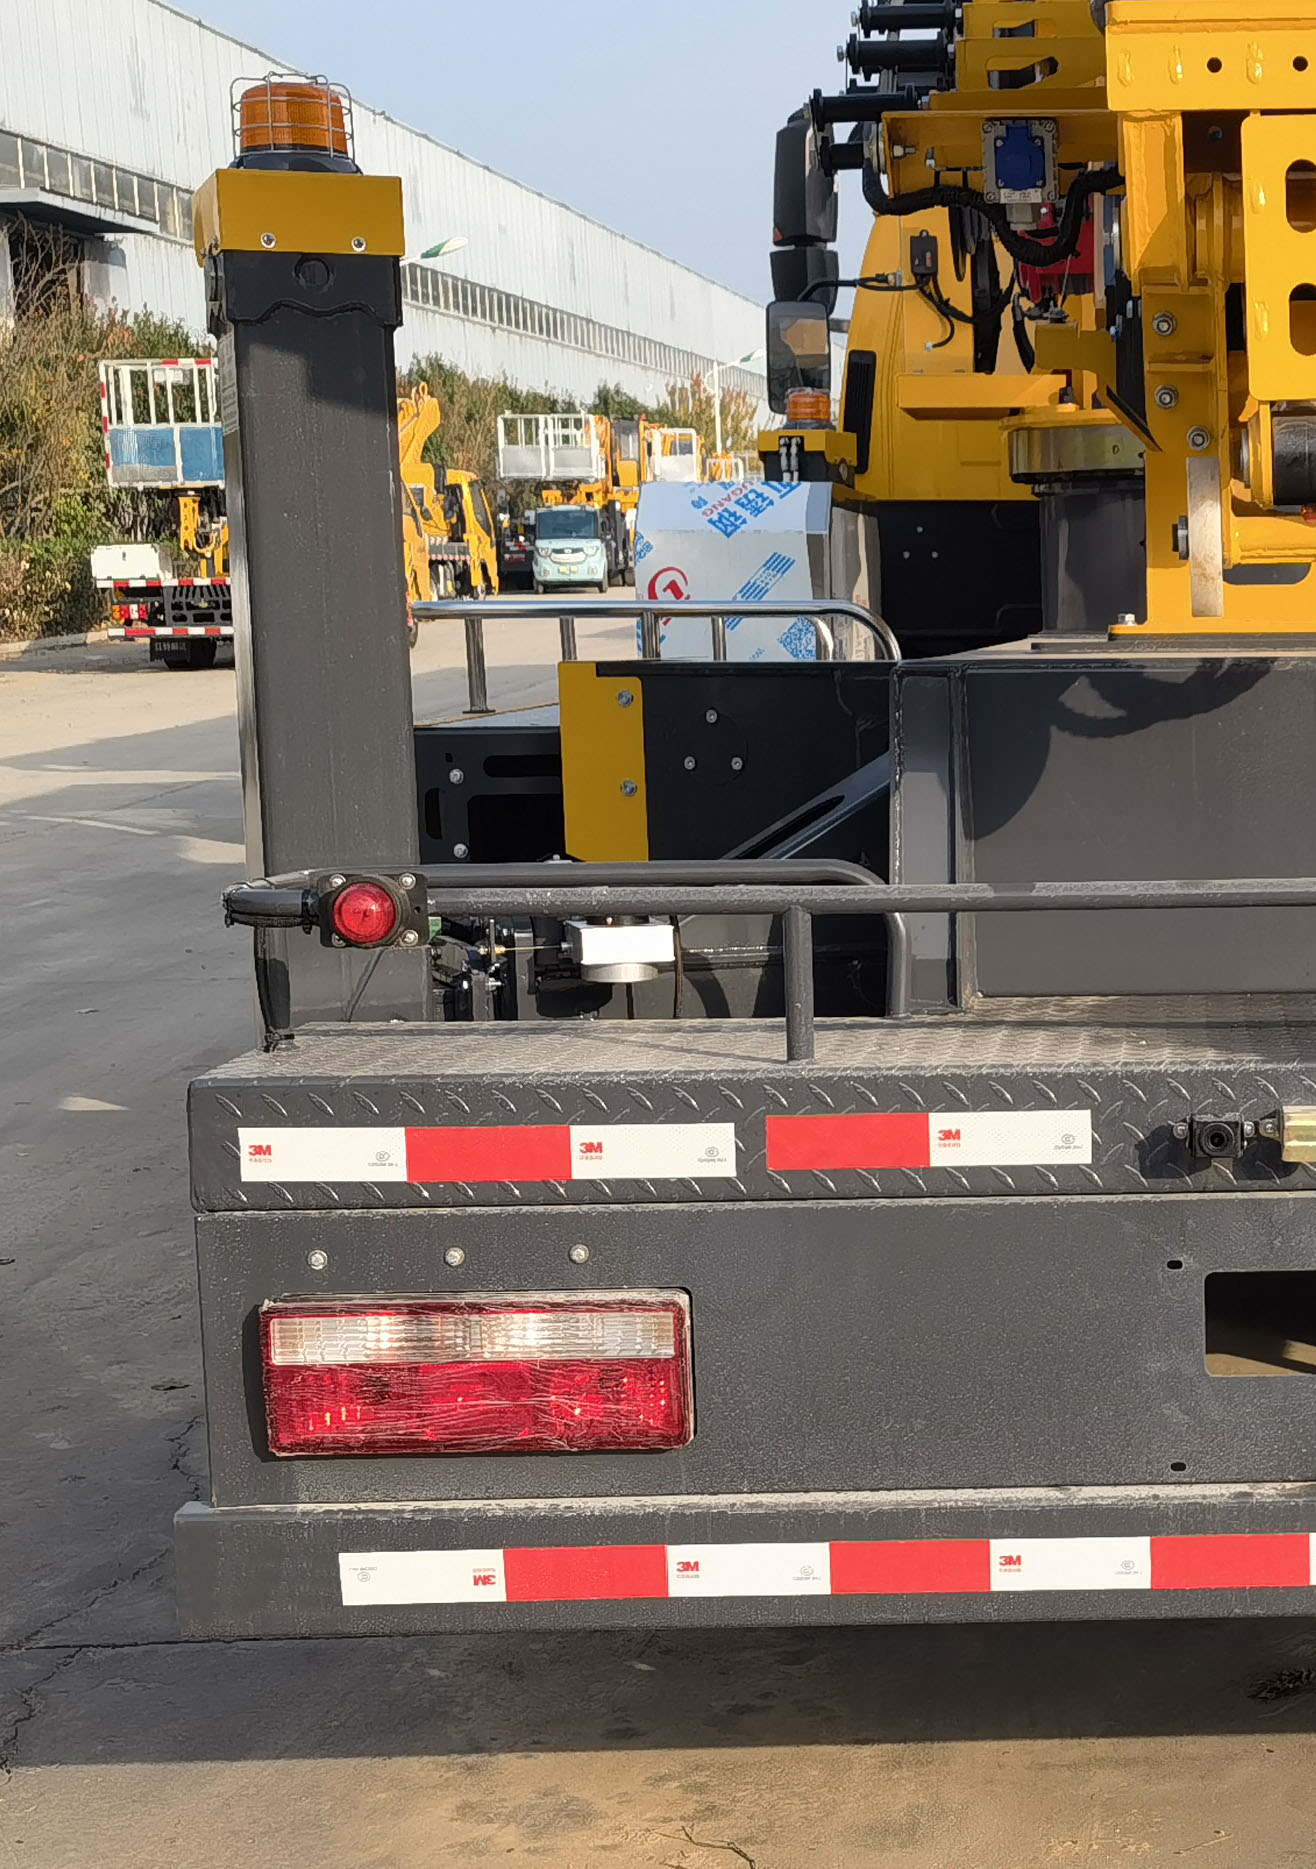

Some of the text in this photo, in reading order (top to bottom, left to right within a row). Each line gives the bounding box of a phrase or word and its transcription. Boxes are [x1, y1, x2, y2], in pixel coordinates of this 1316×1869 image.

[938, 1128, 961, 1141] 3M
[248, 1144, 272, 1156] 3M
[580, 1141, 603, 1153] 3M
[677, 1561, 700, 1572] 3M
[999, 1555, 1022, 1567] 3M
